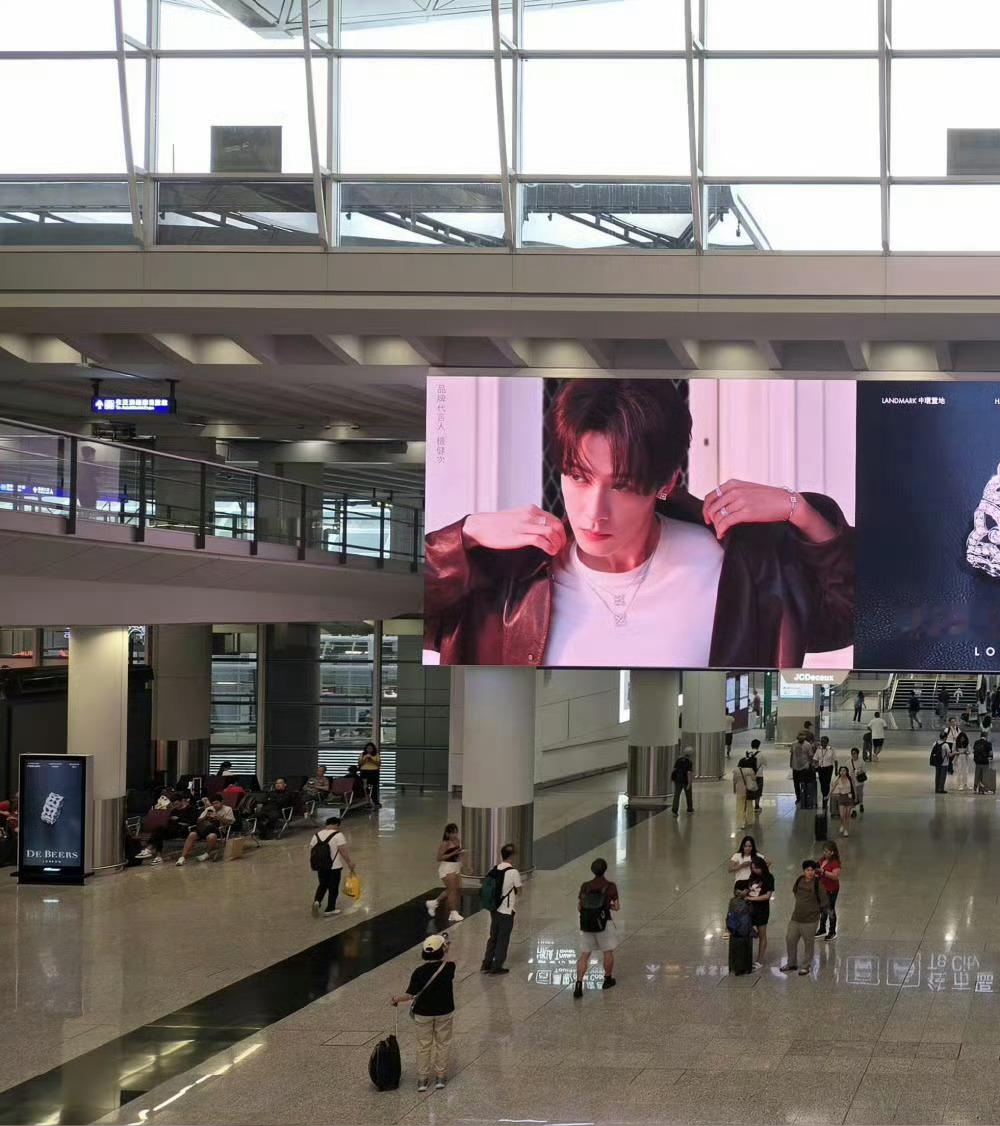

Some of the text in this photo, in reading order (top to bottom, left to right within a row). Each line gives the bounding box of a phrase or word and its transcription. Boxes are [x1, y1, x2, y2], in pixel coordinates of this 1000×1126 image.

[881, 397, 918, 405] LANDMARK
[26, 849, 79, 859] DE BEERS
